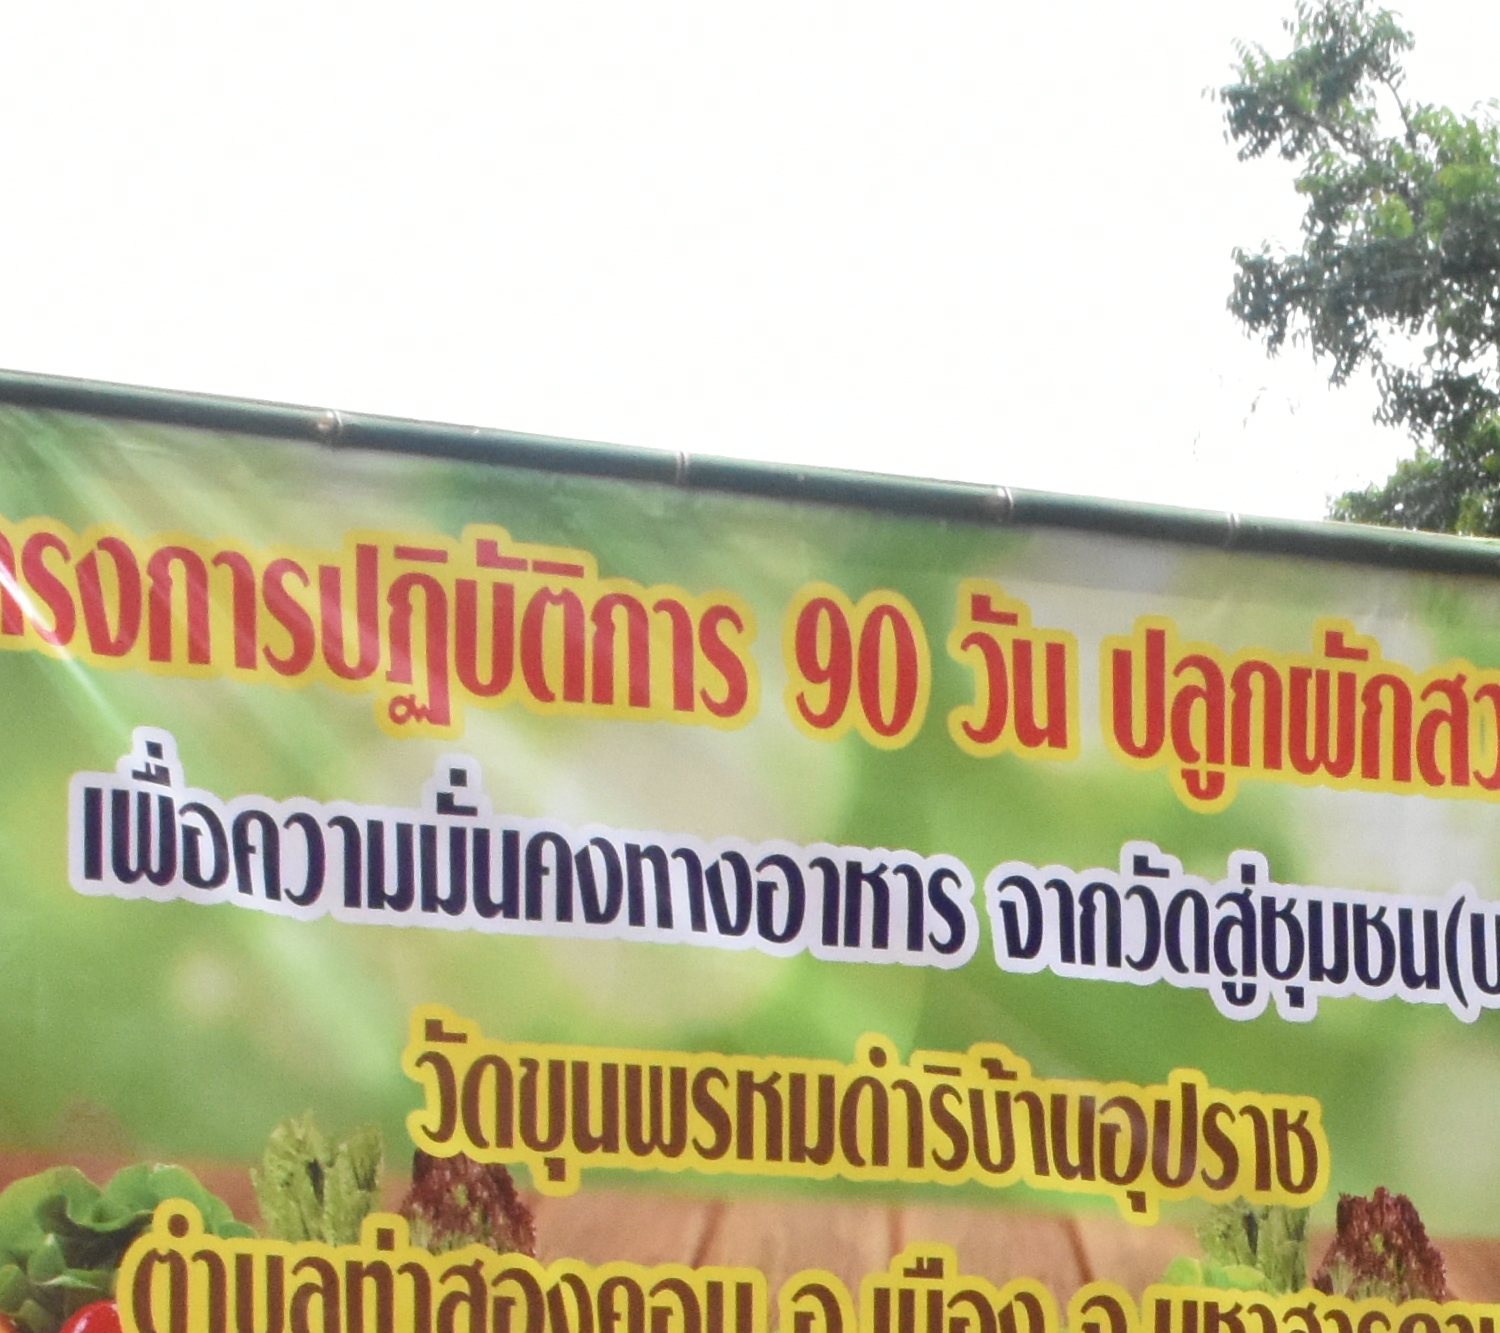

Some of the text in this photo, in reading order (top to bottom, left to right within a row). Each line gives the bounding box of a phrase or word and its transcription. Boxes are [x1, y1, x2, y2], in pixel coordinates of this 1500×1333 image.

[794, 596, 920, 738] 90
[959, 593, 1068, 750] วัน
[82, 740, 968, 958] เพื่อความมั่นคงทางอาหาร
[414, 1018, 1320, 1213] วัดขุนพรหมดำริบ้านอุปราช
